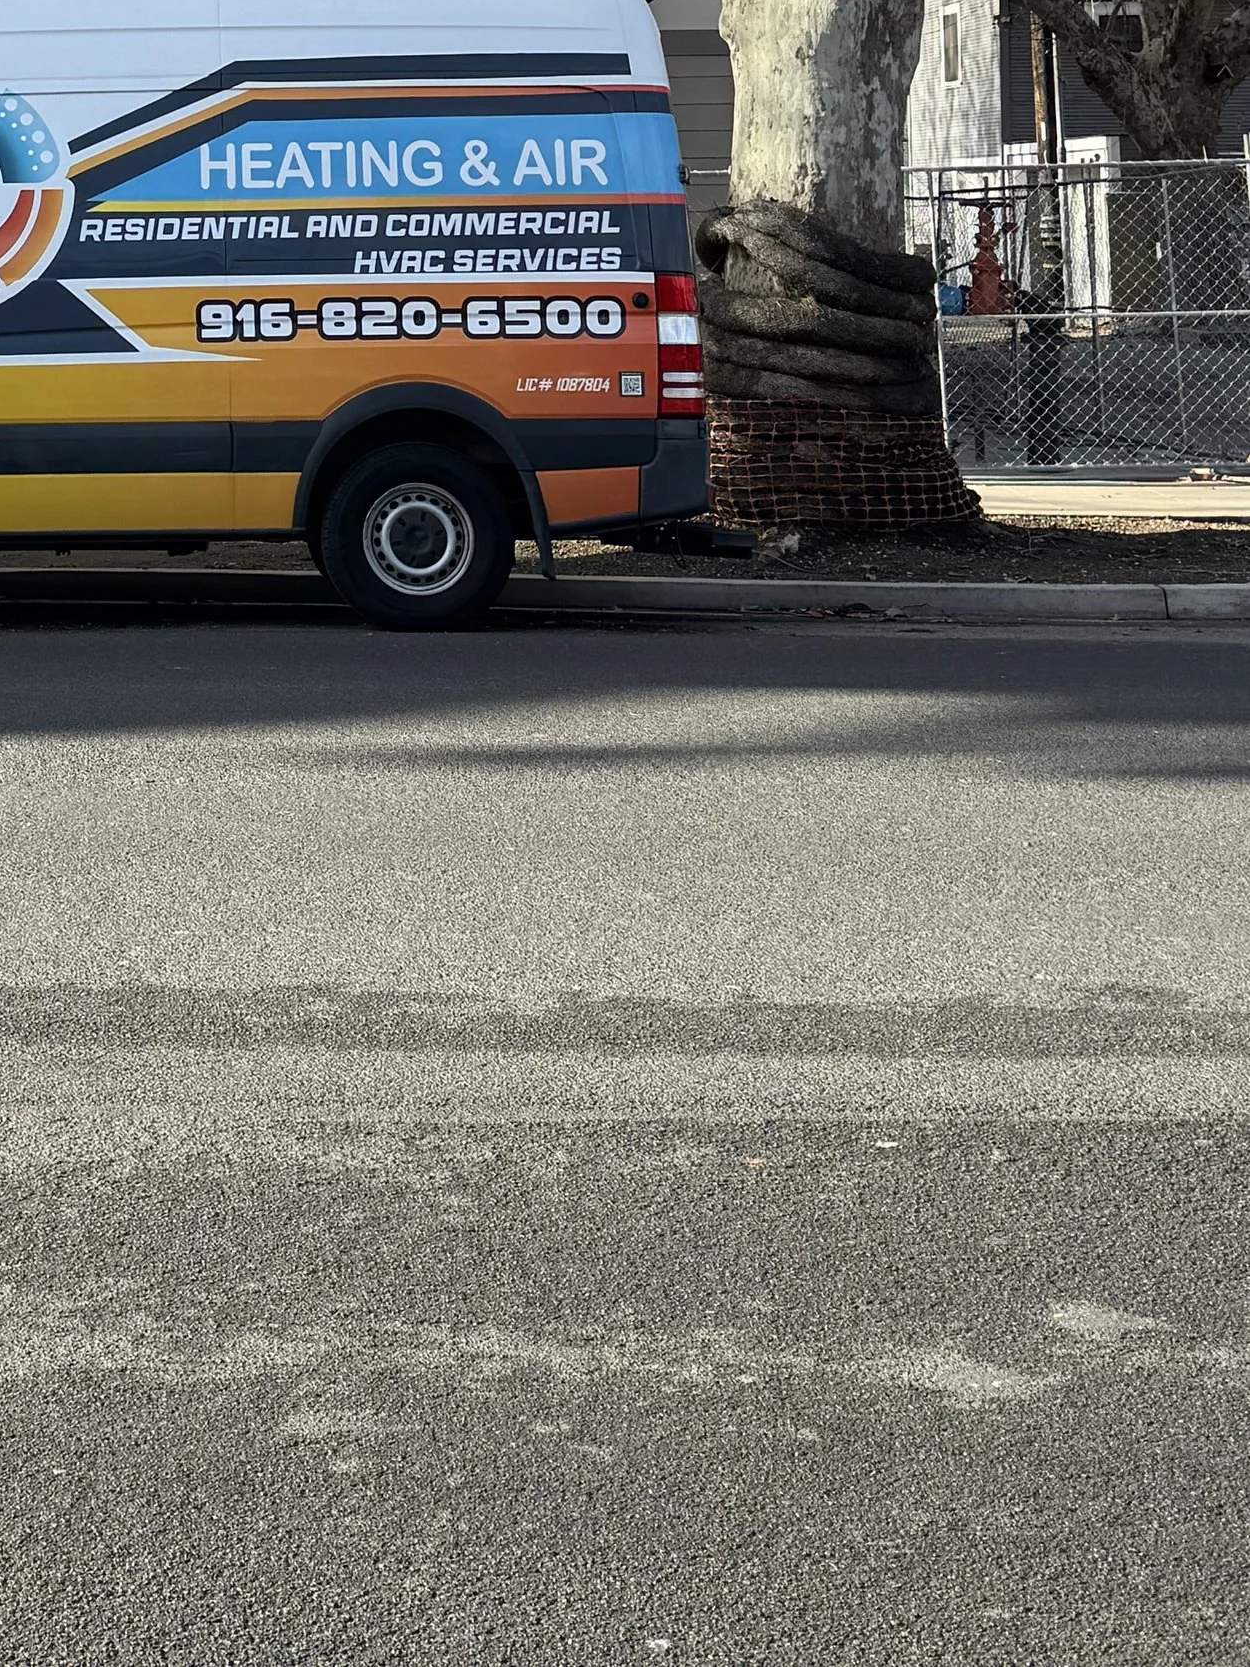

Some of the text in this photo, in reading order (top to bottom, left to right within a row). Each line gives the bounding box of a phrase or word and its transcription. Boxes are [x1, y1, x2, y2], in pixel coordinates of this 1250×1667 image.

[199, 138, 609, 190] HEATING & AIR
[79, 210, 621, 243] RESIDENTIAL AND COMMERCIAL
[353, 246, 623, 275] HVAC SERVICES
[198, 297, 625, 340] 916-820-6500
[555, 377, 611, 393] 1087804
